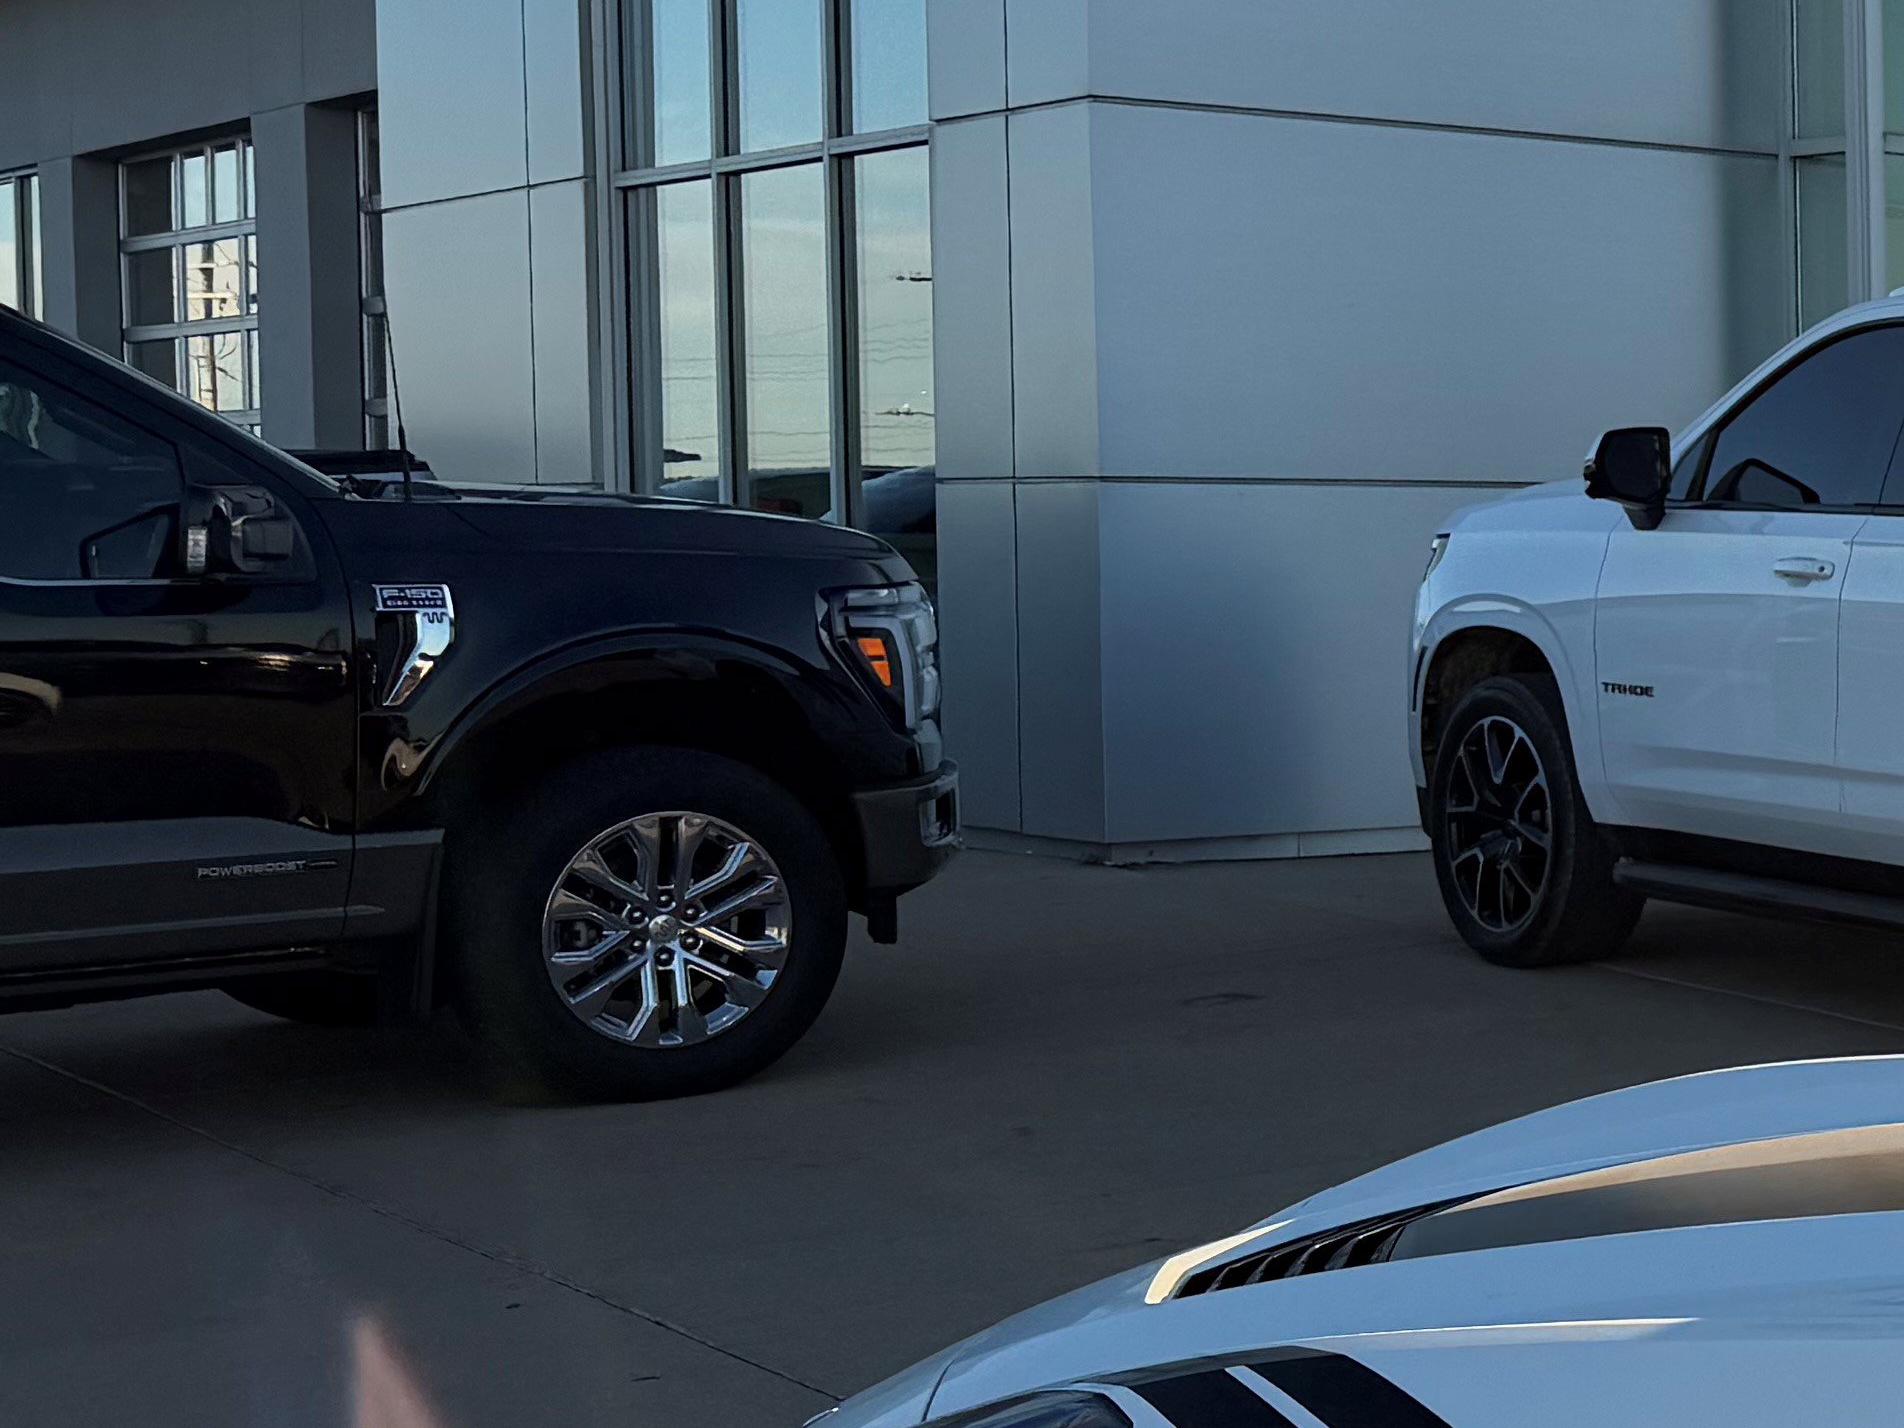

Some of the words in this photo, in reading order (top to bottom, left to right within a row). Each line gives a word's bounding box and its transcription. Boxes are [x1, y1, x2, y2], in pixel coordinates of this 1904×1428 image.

[382, 588, 444, 599] F-150
[1600, 681, 1655, 698] TAHOE
[197, 859, 307, 879] POWERBOOST
